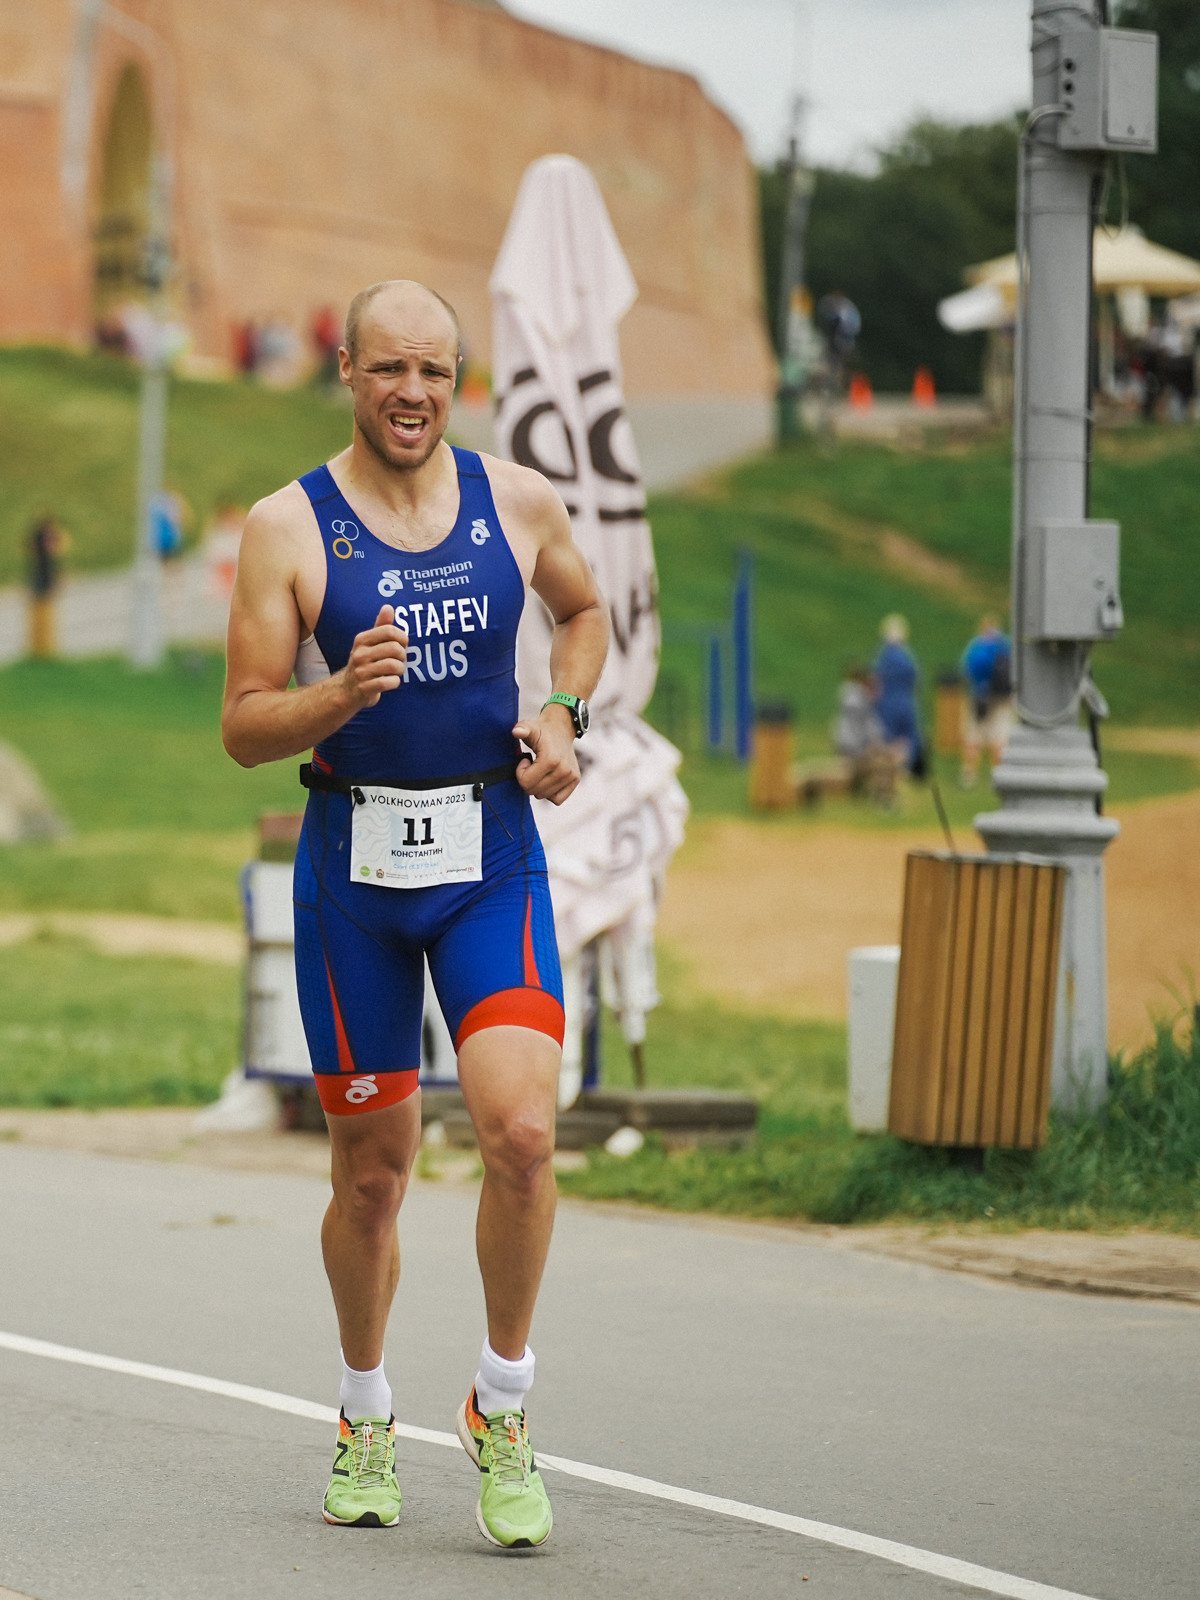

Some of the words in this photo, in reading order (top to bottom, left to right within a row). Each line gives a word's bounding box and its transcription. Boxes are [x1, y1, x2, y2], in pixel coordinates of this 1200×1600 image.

[354, 551, 365, 559] ITU
[404, 560, 473, 581] Champion
[413, 575, 470, 593] System
[394, 595, 488, 638] STAFEV
[404, 639, 469, 683] RUS
[370, 794, 443, 809] VOLKHOVMAN
[445, 793, 466, 805] 2023
[402, 817, 435, 846] 11
[391, 847, 443, 858] КОНСТАНТИН
